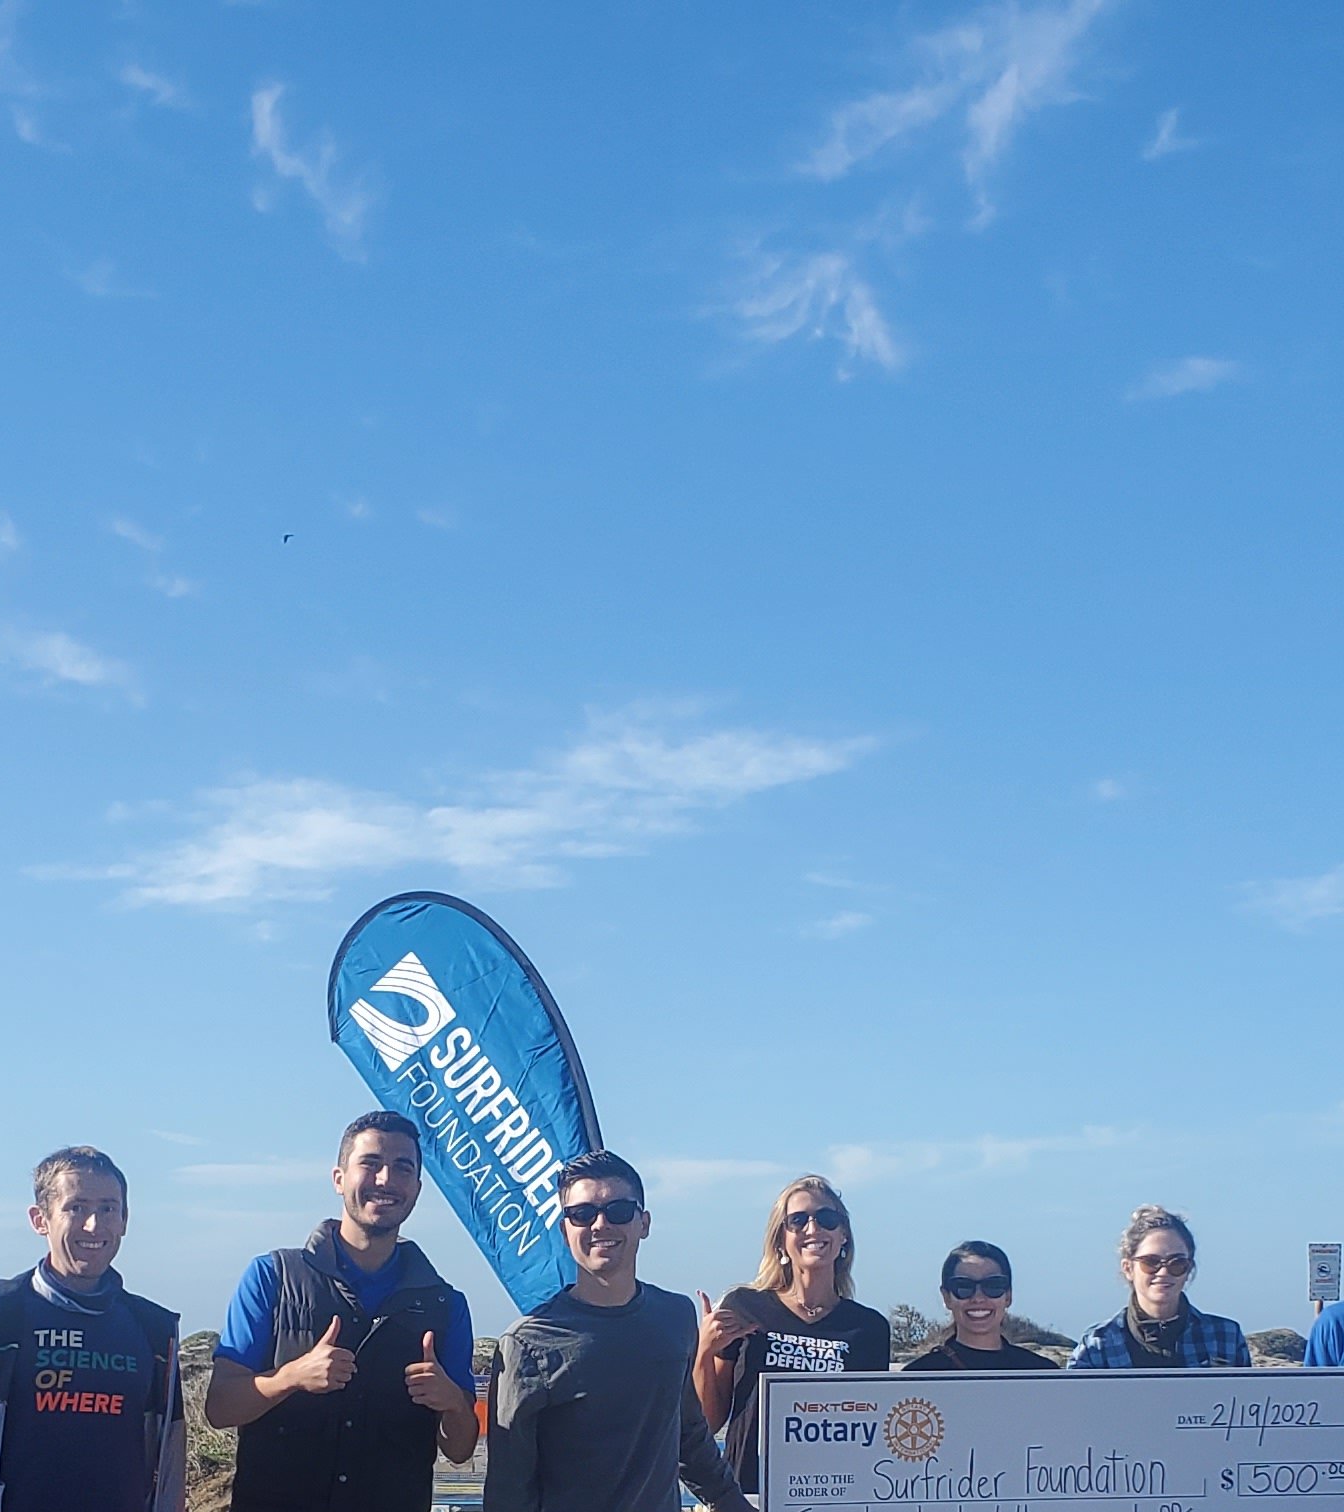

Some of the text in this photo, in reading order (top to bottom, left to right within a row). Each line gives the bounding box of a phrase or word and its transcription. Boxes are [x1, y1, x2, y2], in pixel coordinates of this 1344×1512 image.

[397, 1062, 540, 1256] FOUNDATION
[34, 1329, 83, 1348] THE
[767, 1331, 850, 1354] SURFRIDER
[36, 1349, 138, 1373] SCIENCE
[765, 1352, 845, 1372] DEFENDER
[770, 1342, 844, 1363] COASTAL
[36, 1369, 73, 1389] OF
[36, 1391, 124, 1415] WHERE
[784, 1416, 878, 1447] Rotary
[1177, 1415, 1207, 1425] DATE
[1211, 1396, 1321, 1446] 2/19/2022
[789, 1474, 854, 1485] PAY TO THE
[873, 1446, 1165, 1501] Surfrider Foundation
[1220, 1467, 1235, 1490] $
[788, 1487, 847, 1498] ORDER OF
